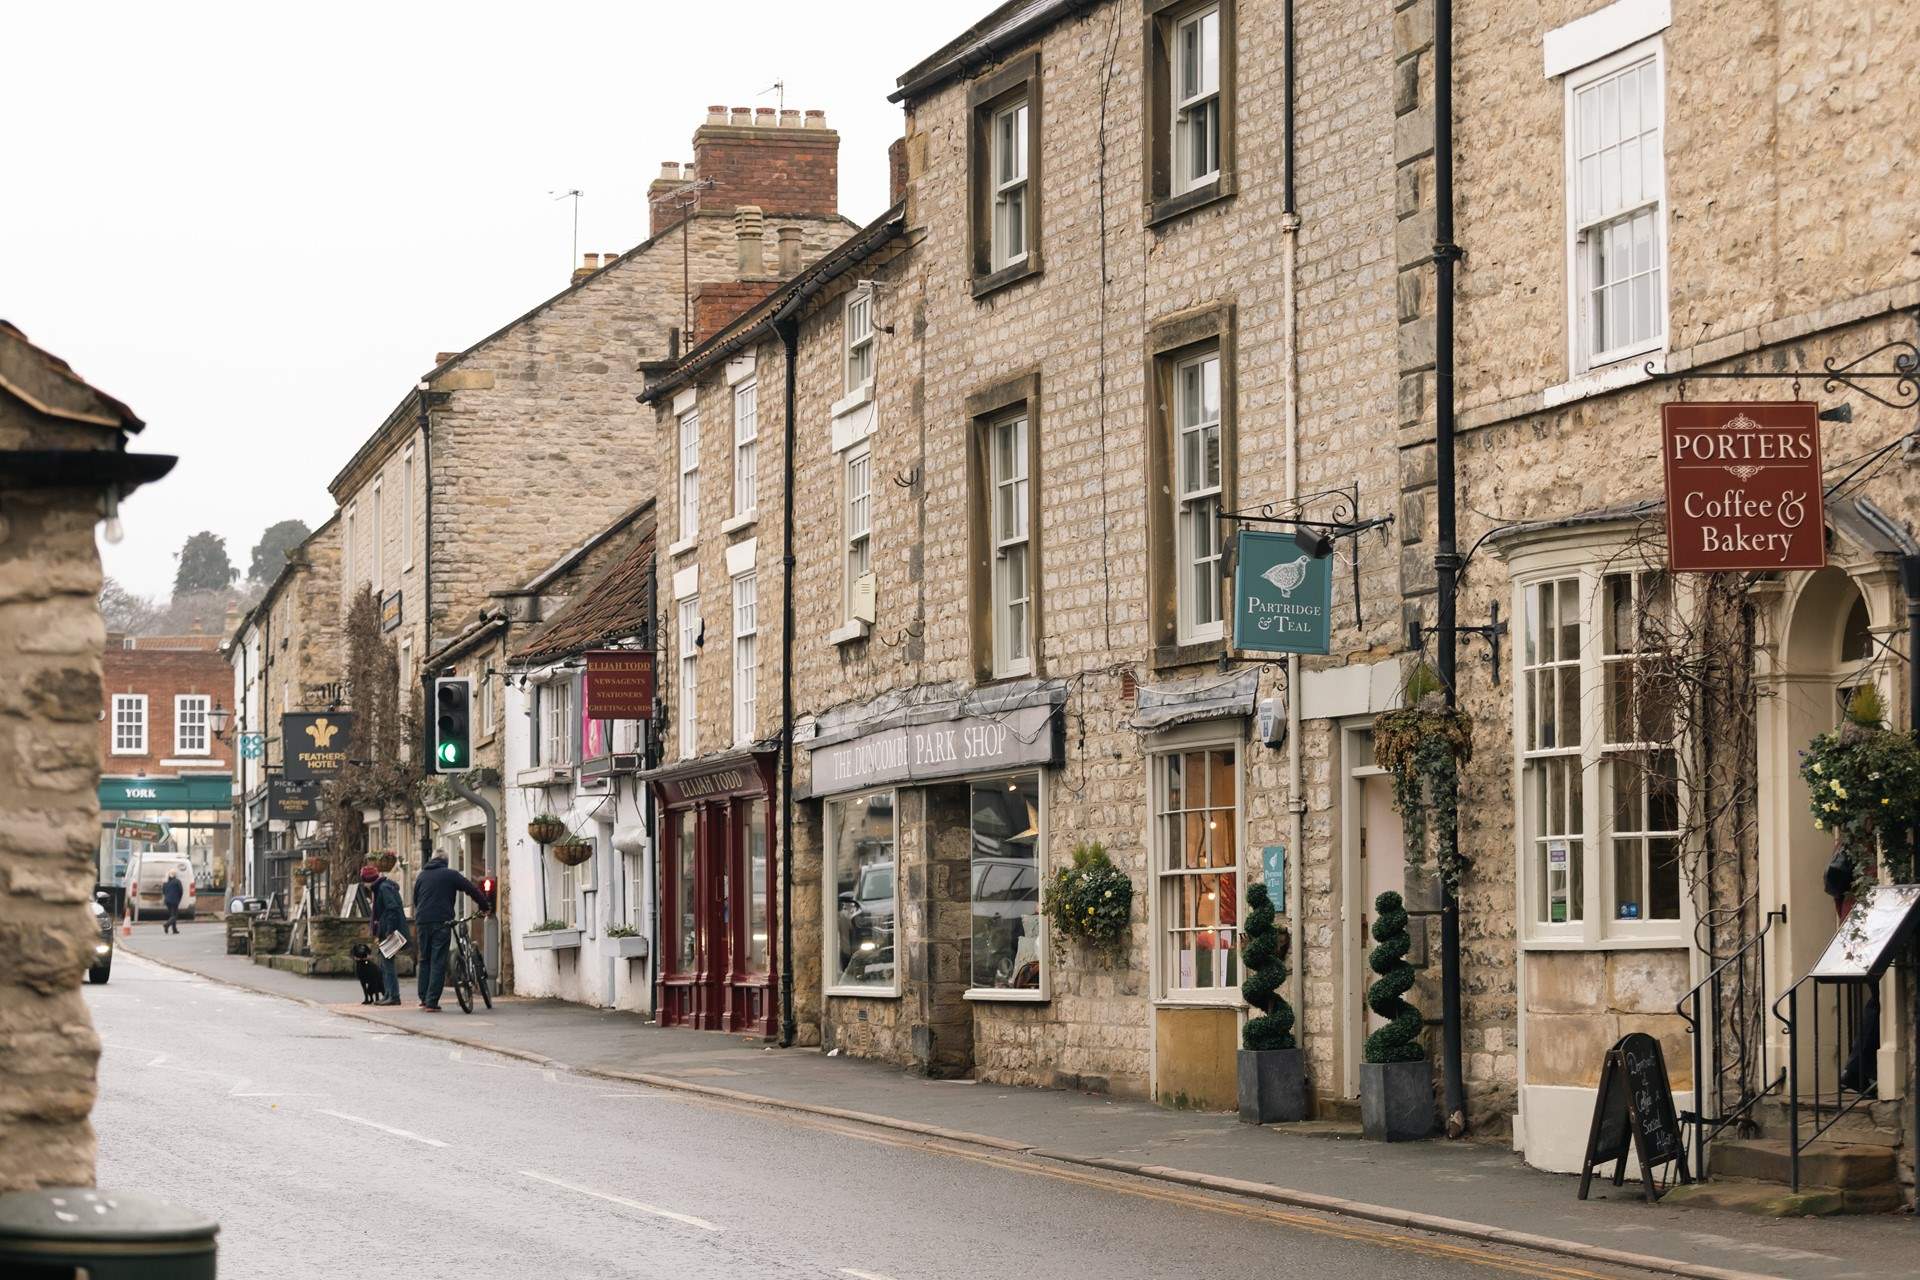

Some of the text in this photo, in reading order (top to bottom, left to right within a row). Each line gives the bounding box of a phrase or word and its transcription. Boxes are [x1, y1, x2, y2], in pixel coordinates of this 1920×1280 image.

[1673, 433, 1813, 460] PORTERS
[1684, 489, 1807, 528] Coffee &
[1700, 523, 1794, 562] Bakery
[1258, 616, 1272, 630] &
[588, 662, 651, 671] ELIJAH TODD
[589, 704, 652, 712] GREETING CARDS
[298, 752, 346, 761] FEATHERS
[833, 749, 852, 780] THE
[915, 730, 958, 765] PARK
[964, 723, 1007, 760] SHOP
[307, 760, 338, 768] HOTEL
[678, 770, 743, 798] ELIJAH TODD
[125, 787, 157, 798] YORK
